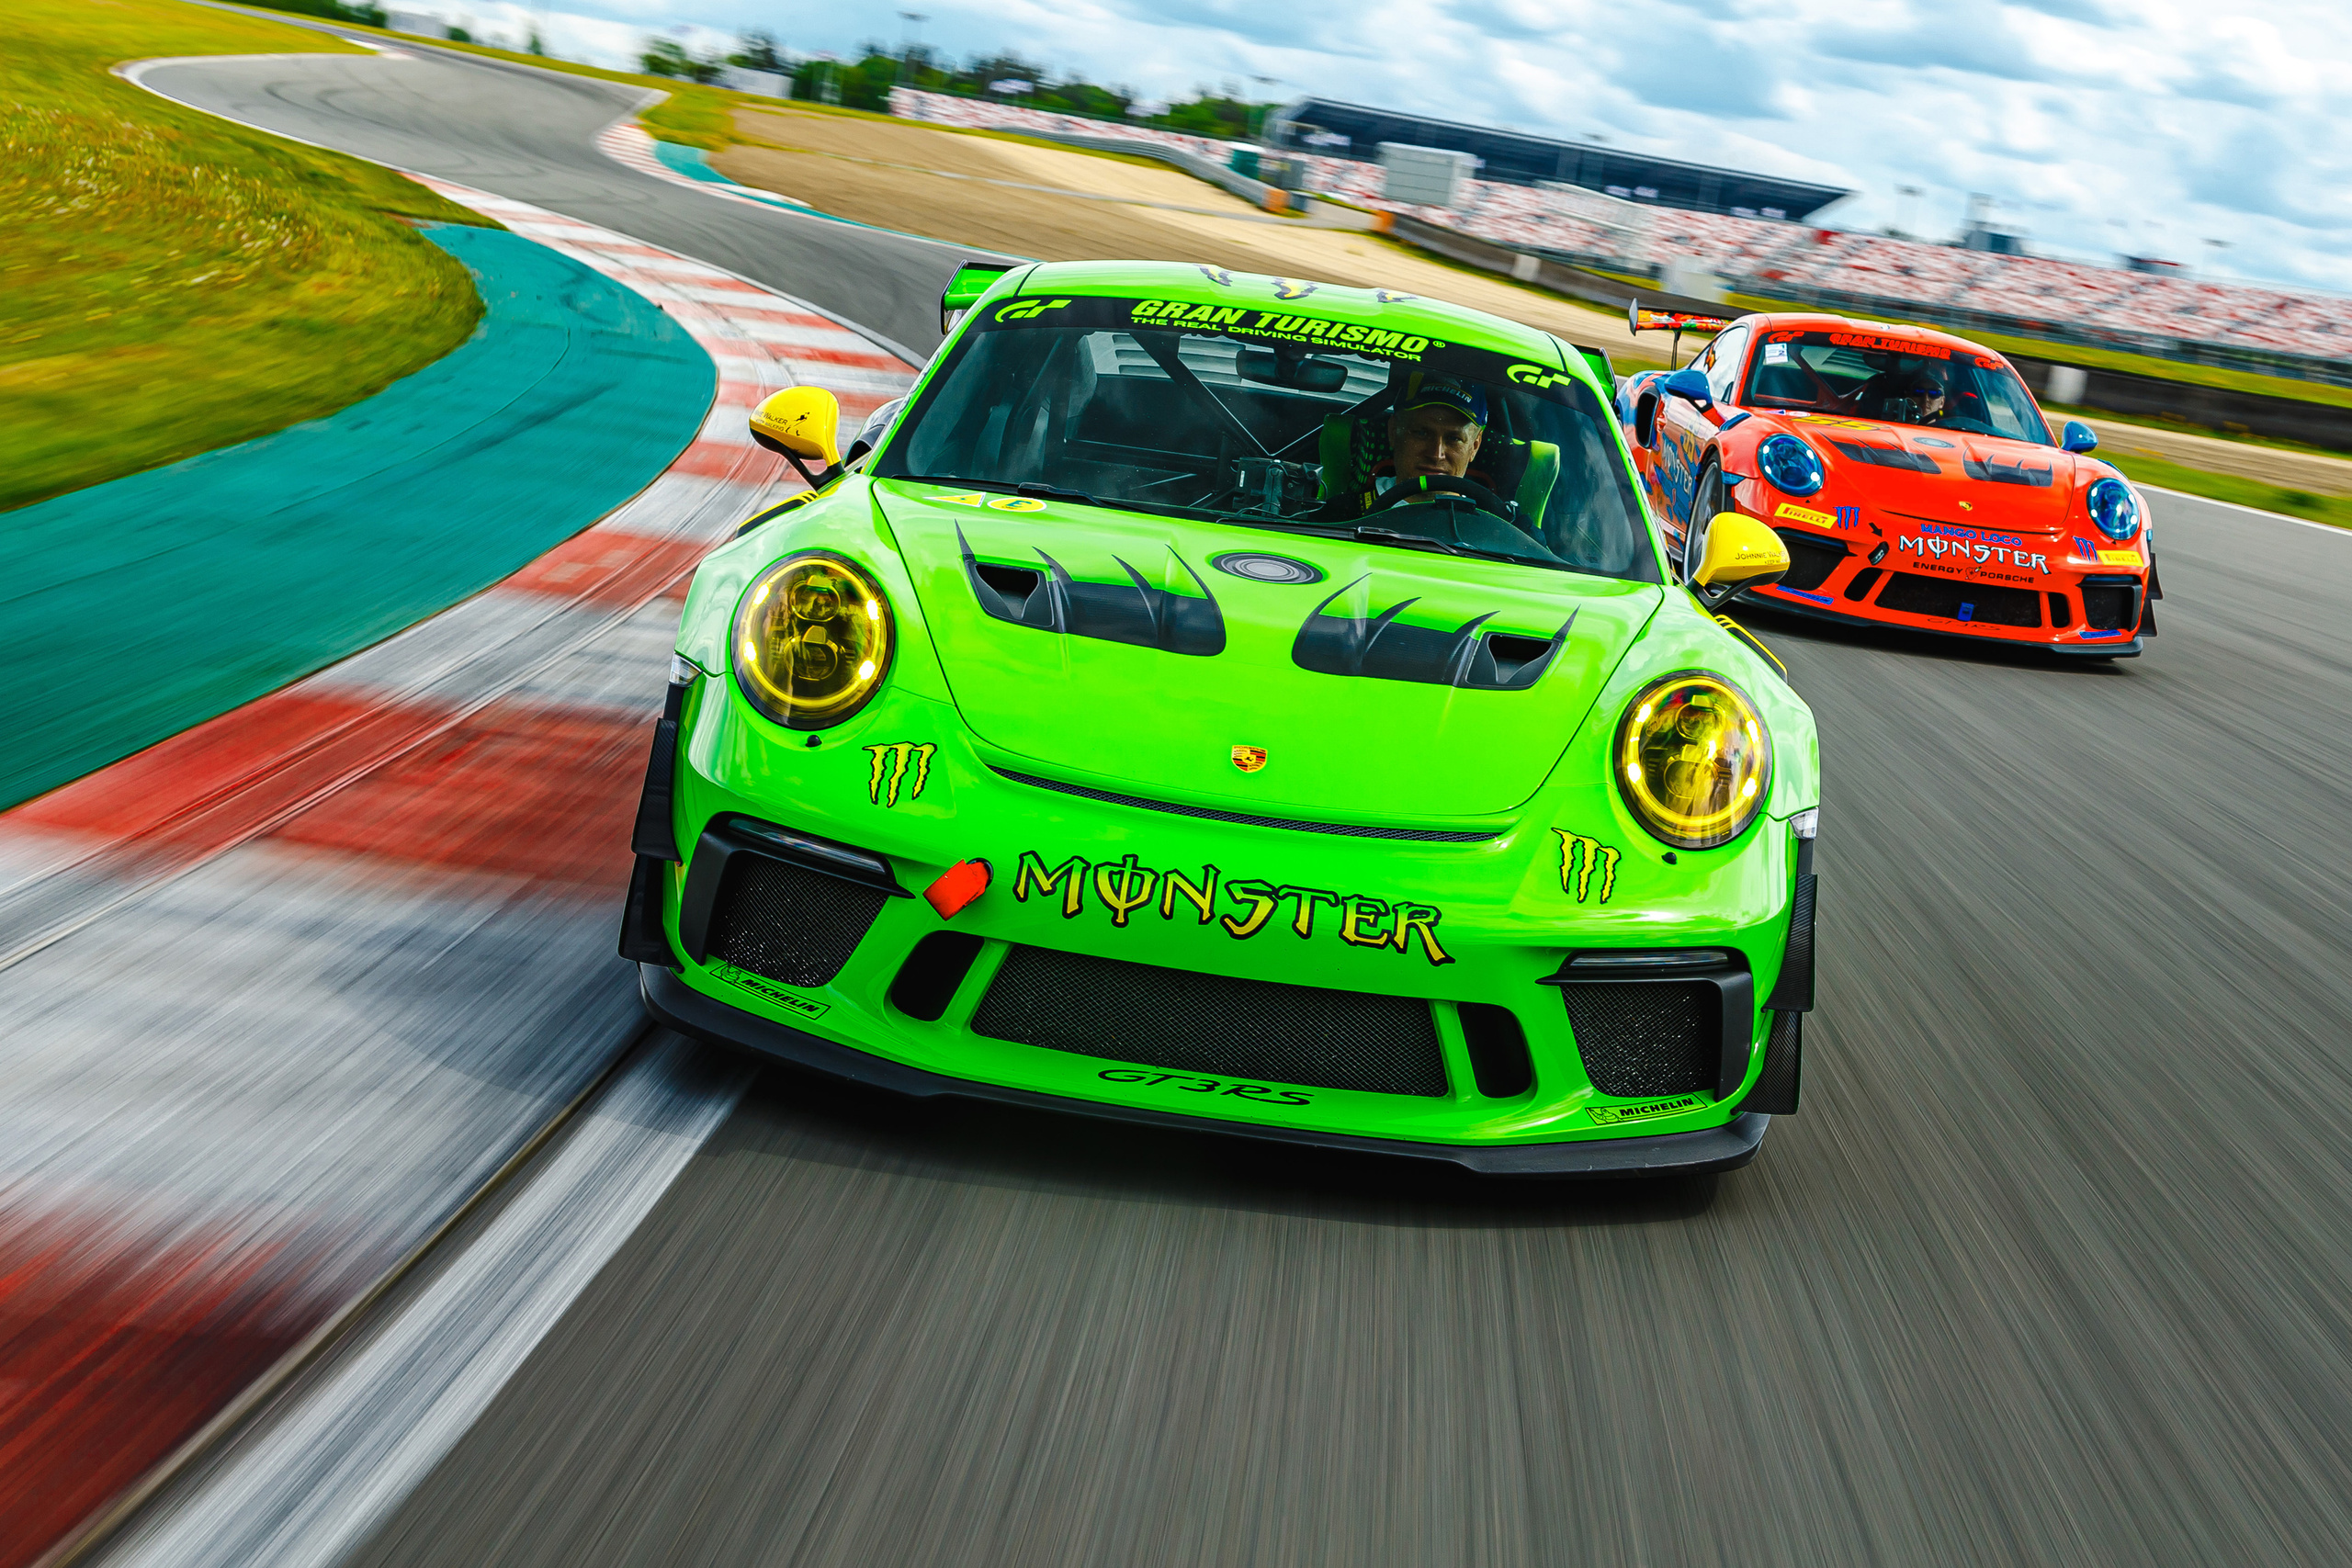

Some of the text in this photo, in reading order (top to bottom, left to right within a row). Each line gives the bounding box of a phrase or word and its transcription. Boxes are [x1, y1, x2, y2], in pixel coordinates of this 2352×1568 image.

[1131, 299, 1247, 325] GRAN
[1130, 317, 1422, 363] THE REAL DRIVING SIMULATOR
[1828, 333, 1877, 346] GRAN
[1880, 337, 1951, 359] TURISMO
[1420, 385, 1472, 403] MICHELIN
[763, 412, 789, 425] WALKER
[1781, 506, 1829, 526] PIRELLI
[1920, 523, 2023, 547] MANGO LOCO
[1735, 552, 1767, 560] JOHNNIE
[1898, 534, 2052, 575] MONSTER
[1913, 561, 2035, 584] ENERGY PORSCHE
[1012, 850, 1456, 967] MONSTER
[741, 978, 820, 1012] MICHELIN
[1619, 1098, 1694, 1117] MICHELIN
